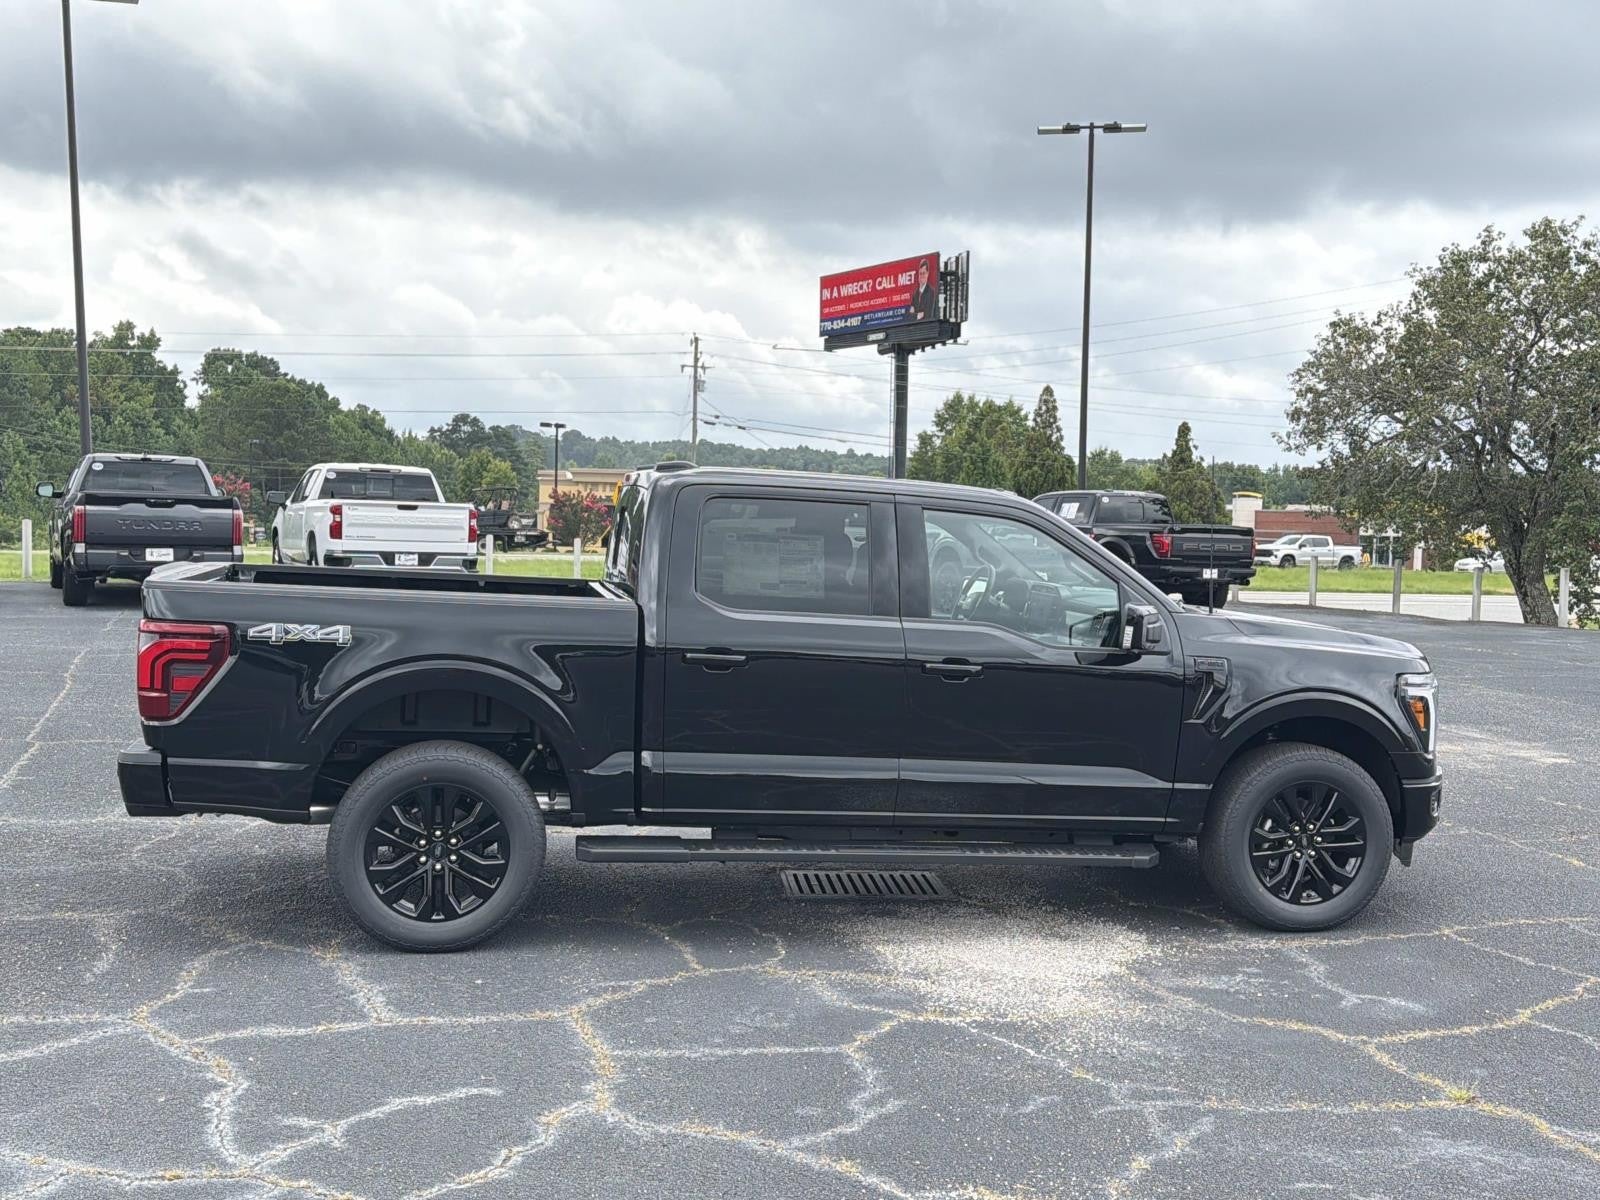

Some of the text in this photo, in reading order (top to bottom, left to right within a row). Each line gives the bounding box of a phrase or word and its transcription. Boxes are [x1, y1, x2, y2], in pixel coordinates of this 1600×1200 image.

[822, 271, 916, 300] IN A WRECK? CALL MET
[116, 518, 203, 531] TUNDRA
[1183, 543, 1244, 552] FORD
